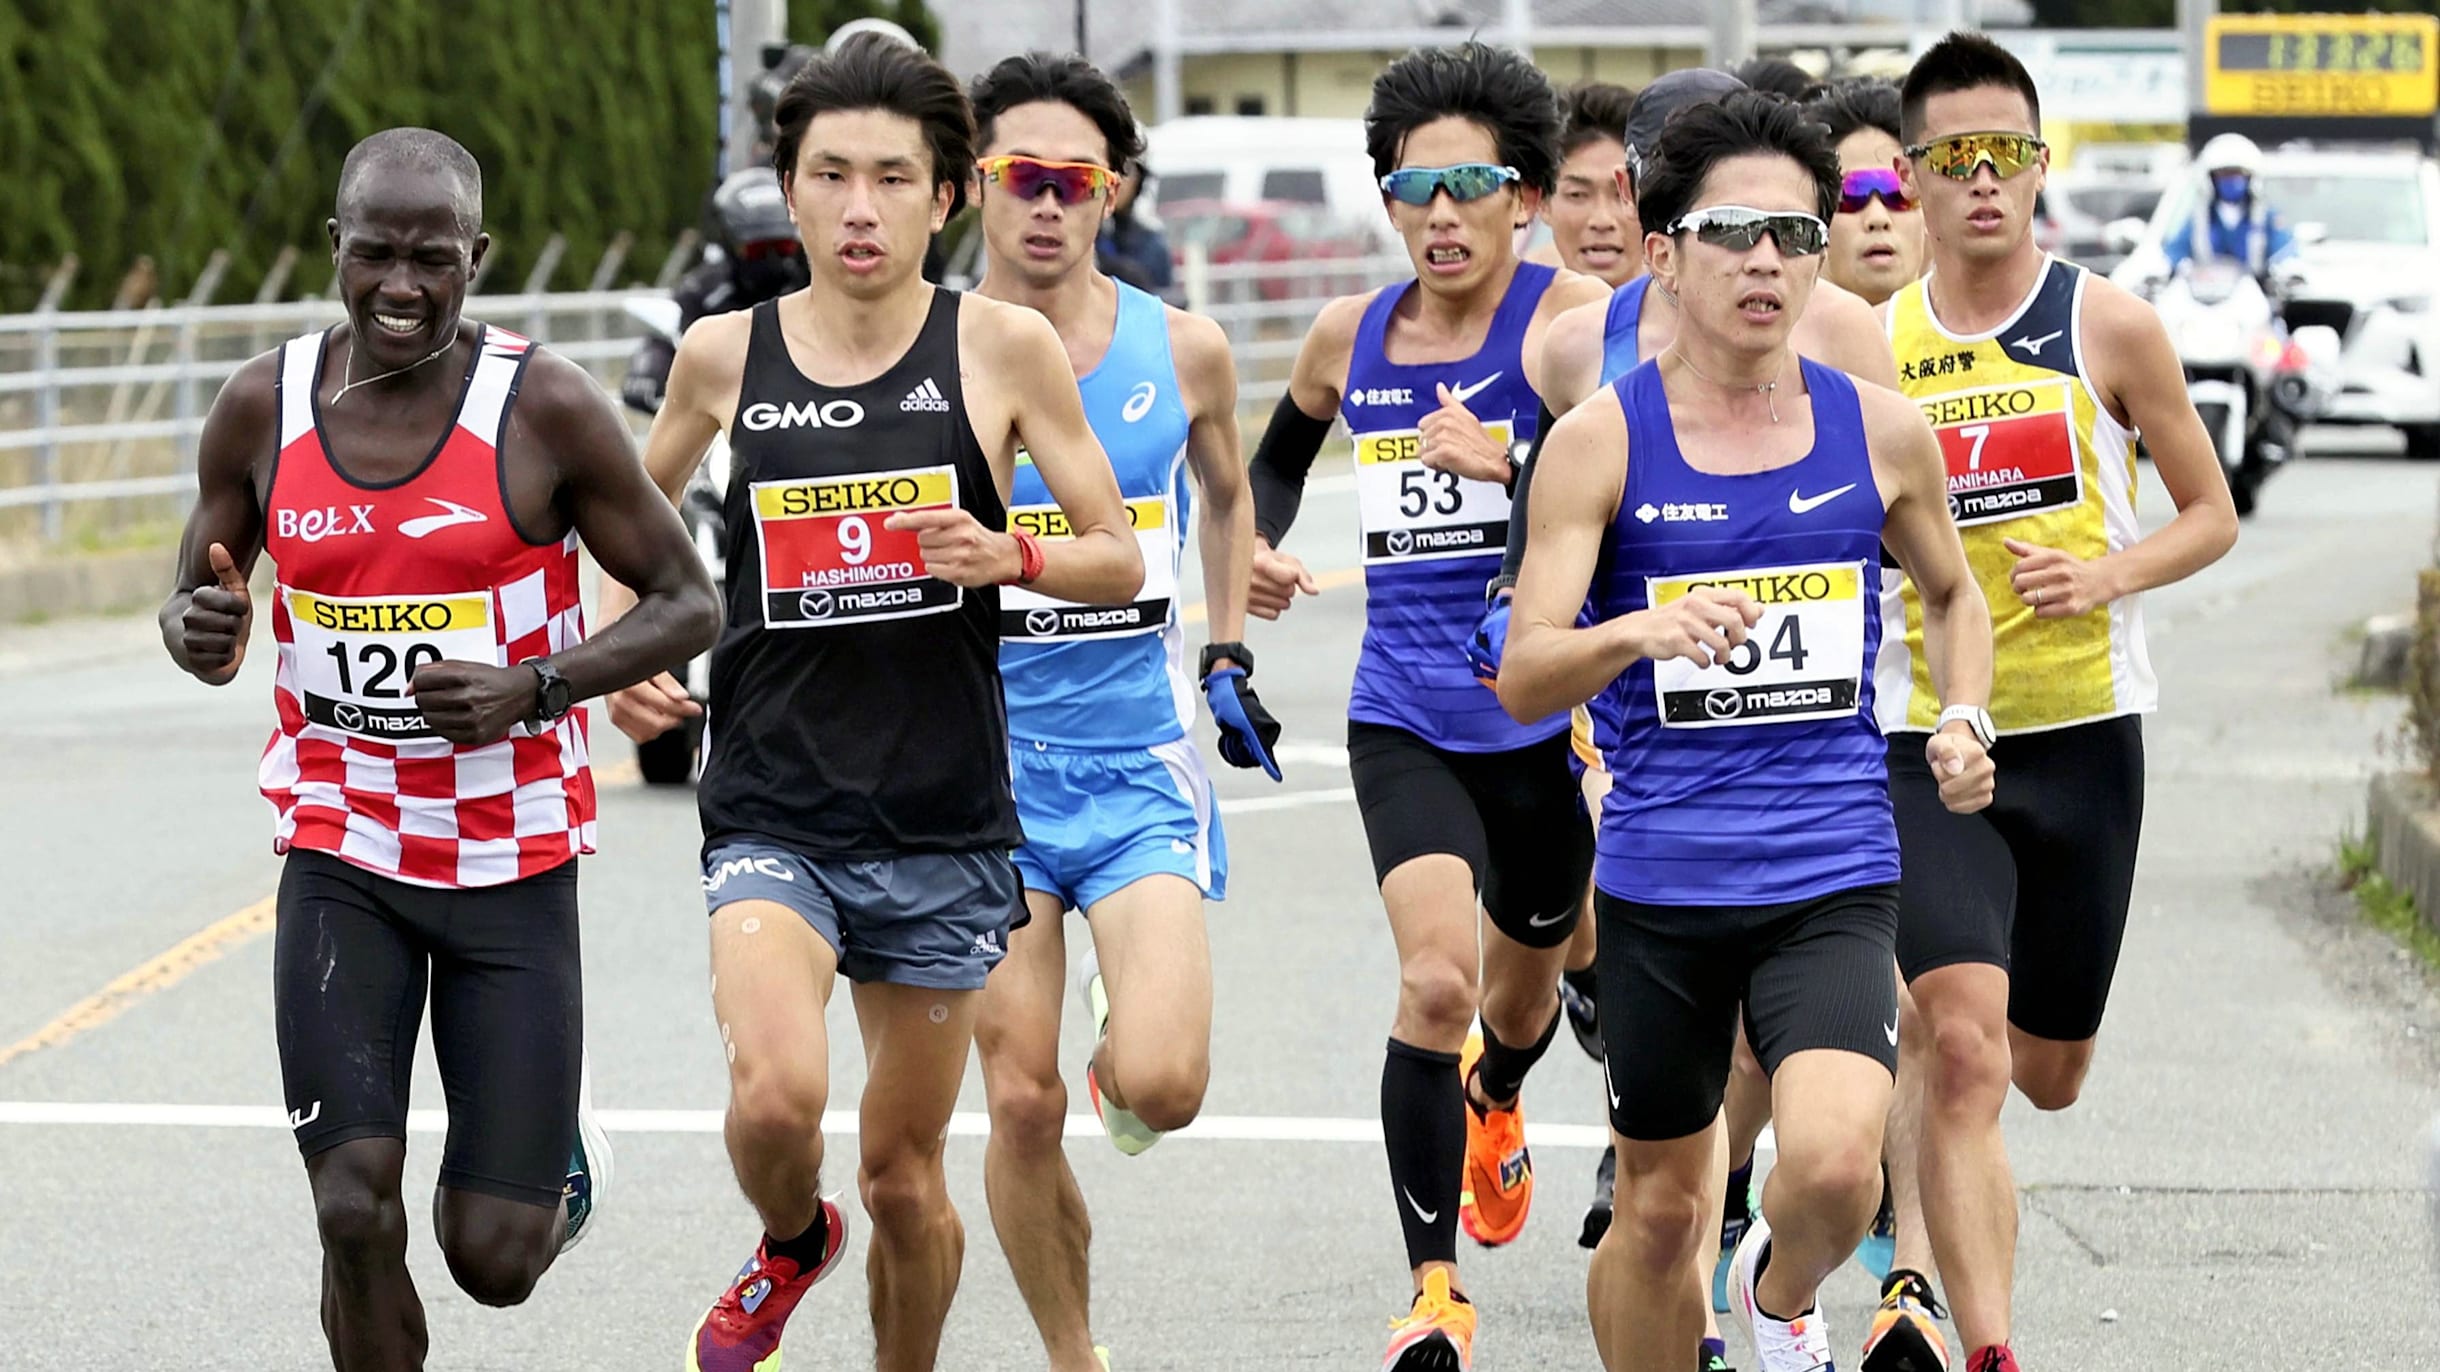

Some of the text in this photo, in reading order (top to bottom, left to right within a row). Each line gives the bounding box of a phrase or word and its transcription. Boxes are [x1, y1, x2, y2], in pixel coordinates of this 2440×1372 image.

[1900, 350, 1976, 382] 大阪府警
[900, 398, 949, 412] adidas
[1366, 388, 1413, 406] 住友電工
[1919, 389, 2035, 426] SEIKO
[742, 399, 865, 432] GMO
[1959, 424, 1990, 471] 7
[1945, 466, 2025, 490] ANIHARA
[782, 478, 919, 515] SEIKO
[1400, 469, 1463, 518] 53
[1964, 488, 2042, 514] mazda
[1662, 503, 1728, 521] 住友電工
[836, 516, 872, 565] 9
[1416, 528, 1484, 548] mazda
[802, 562, 913, 586] HASHIMOTO
[838, 587, 922, 610] mazda
[314, 601, 452, 632] SEIKO
[1063, 608, 1140, 628] mazda
[1747, 688, 1832, 709] mazda
